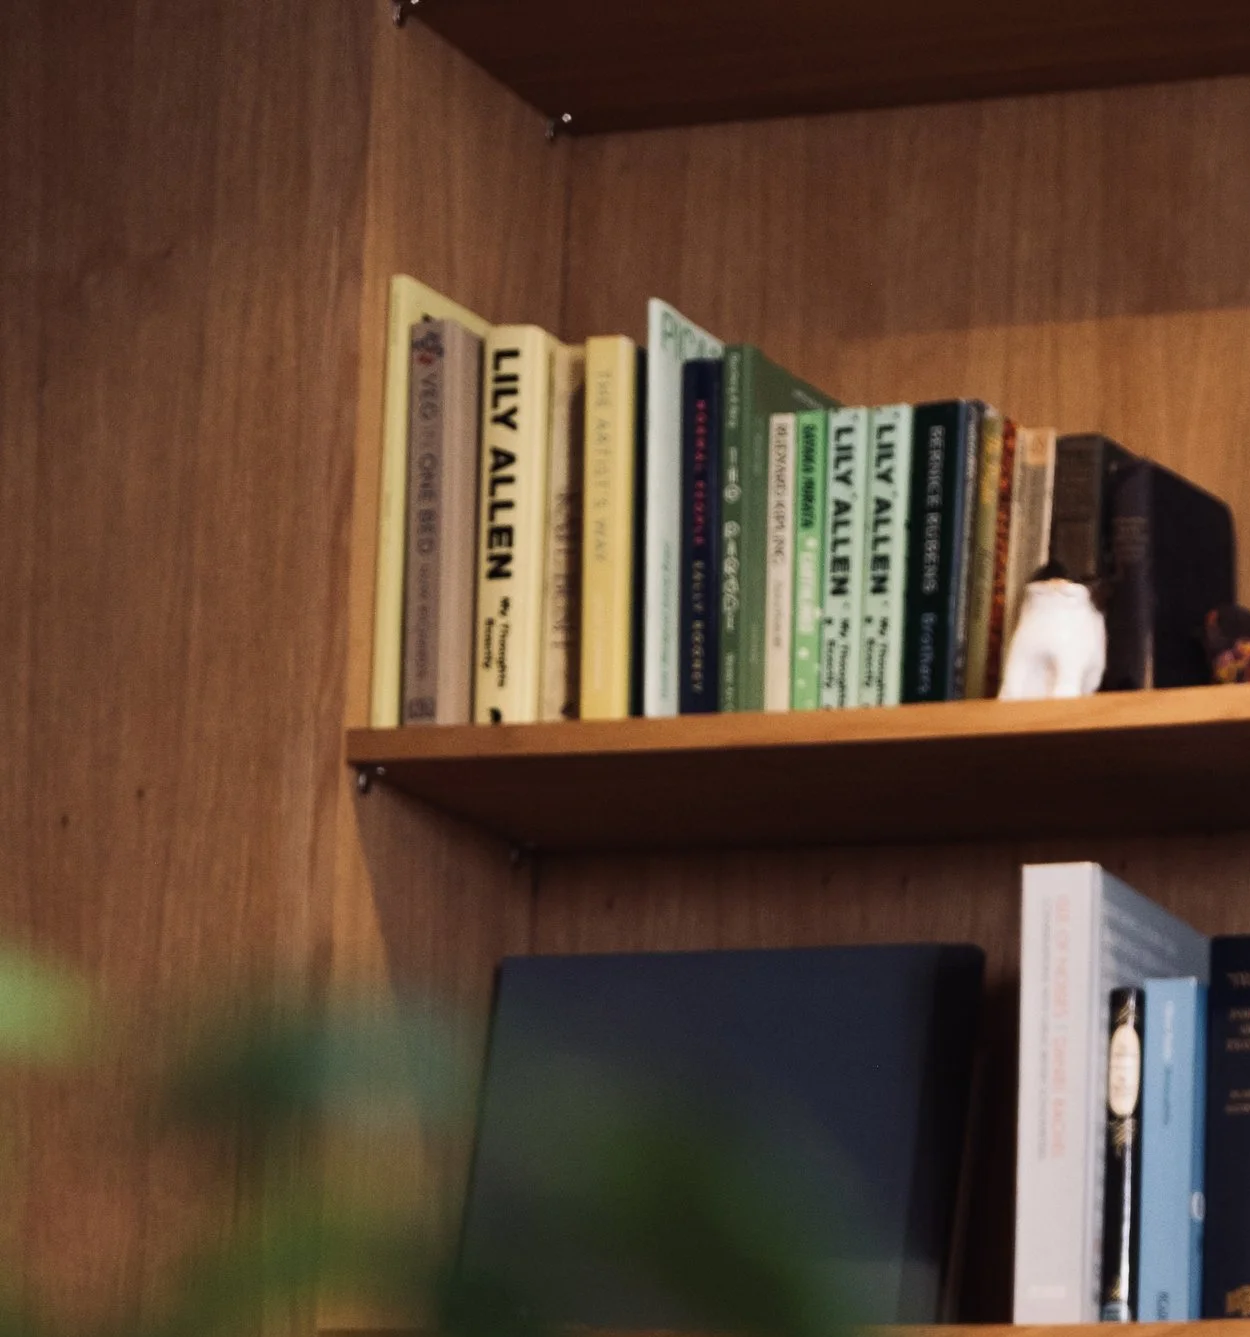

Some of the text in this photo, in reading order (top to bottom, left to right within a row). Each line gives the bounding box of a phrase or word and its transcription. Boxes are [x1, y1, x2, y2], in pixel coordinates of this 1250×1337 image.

[491, 348, 521, 432] LILY
[595, 369, 612, 408] THE
[418, 452, 436, 501] ONE
[487, 447, 517, 581] ALLEN
[829, 426, 854, 597] LILY ALLEN
[870, 424, 895, 595] LILY ALLEN
[417, 508, 436, 555] BED
[593, 520, 608, 564] WAY
[918, 425, 945, 694] BERNICE RUBENS Brothers
[496, 623, 511, 689] Thoughts
